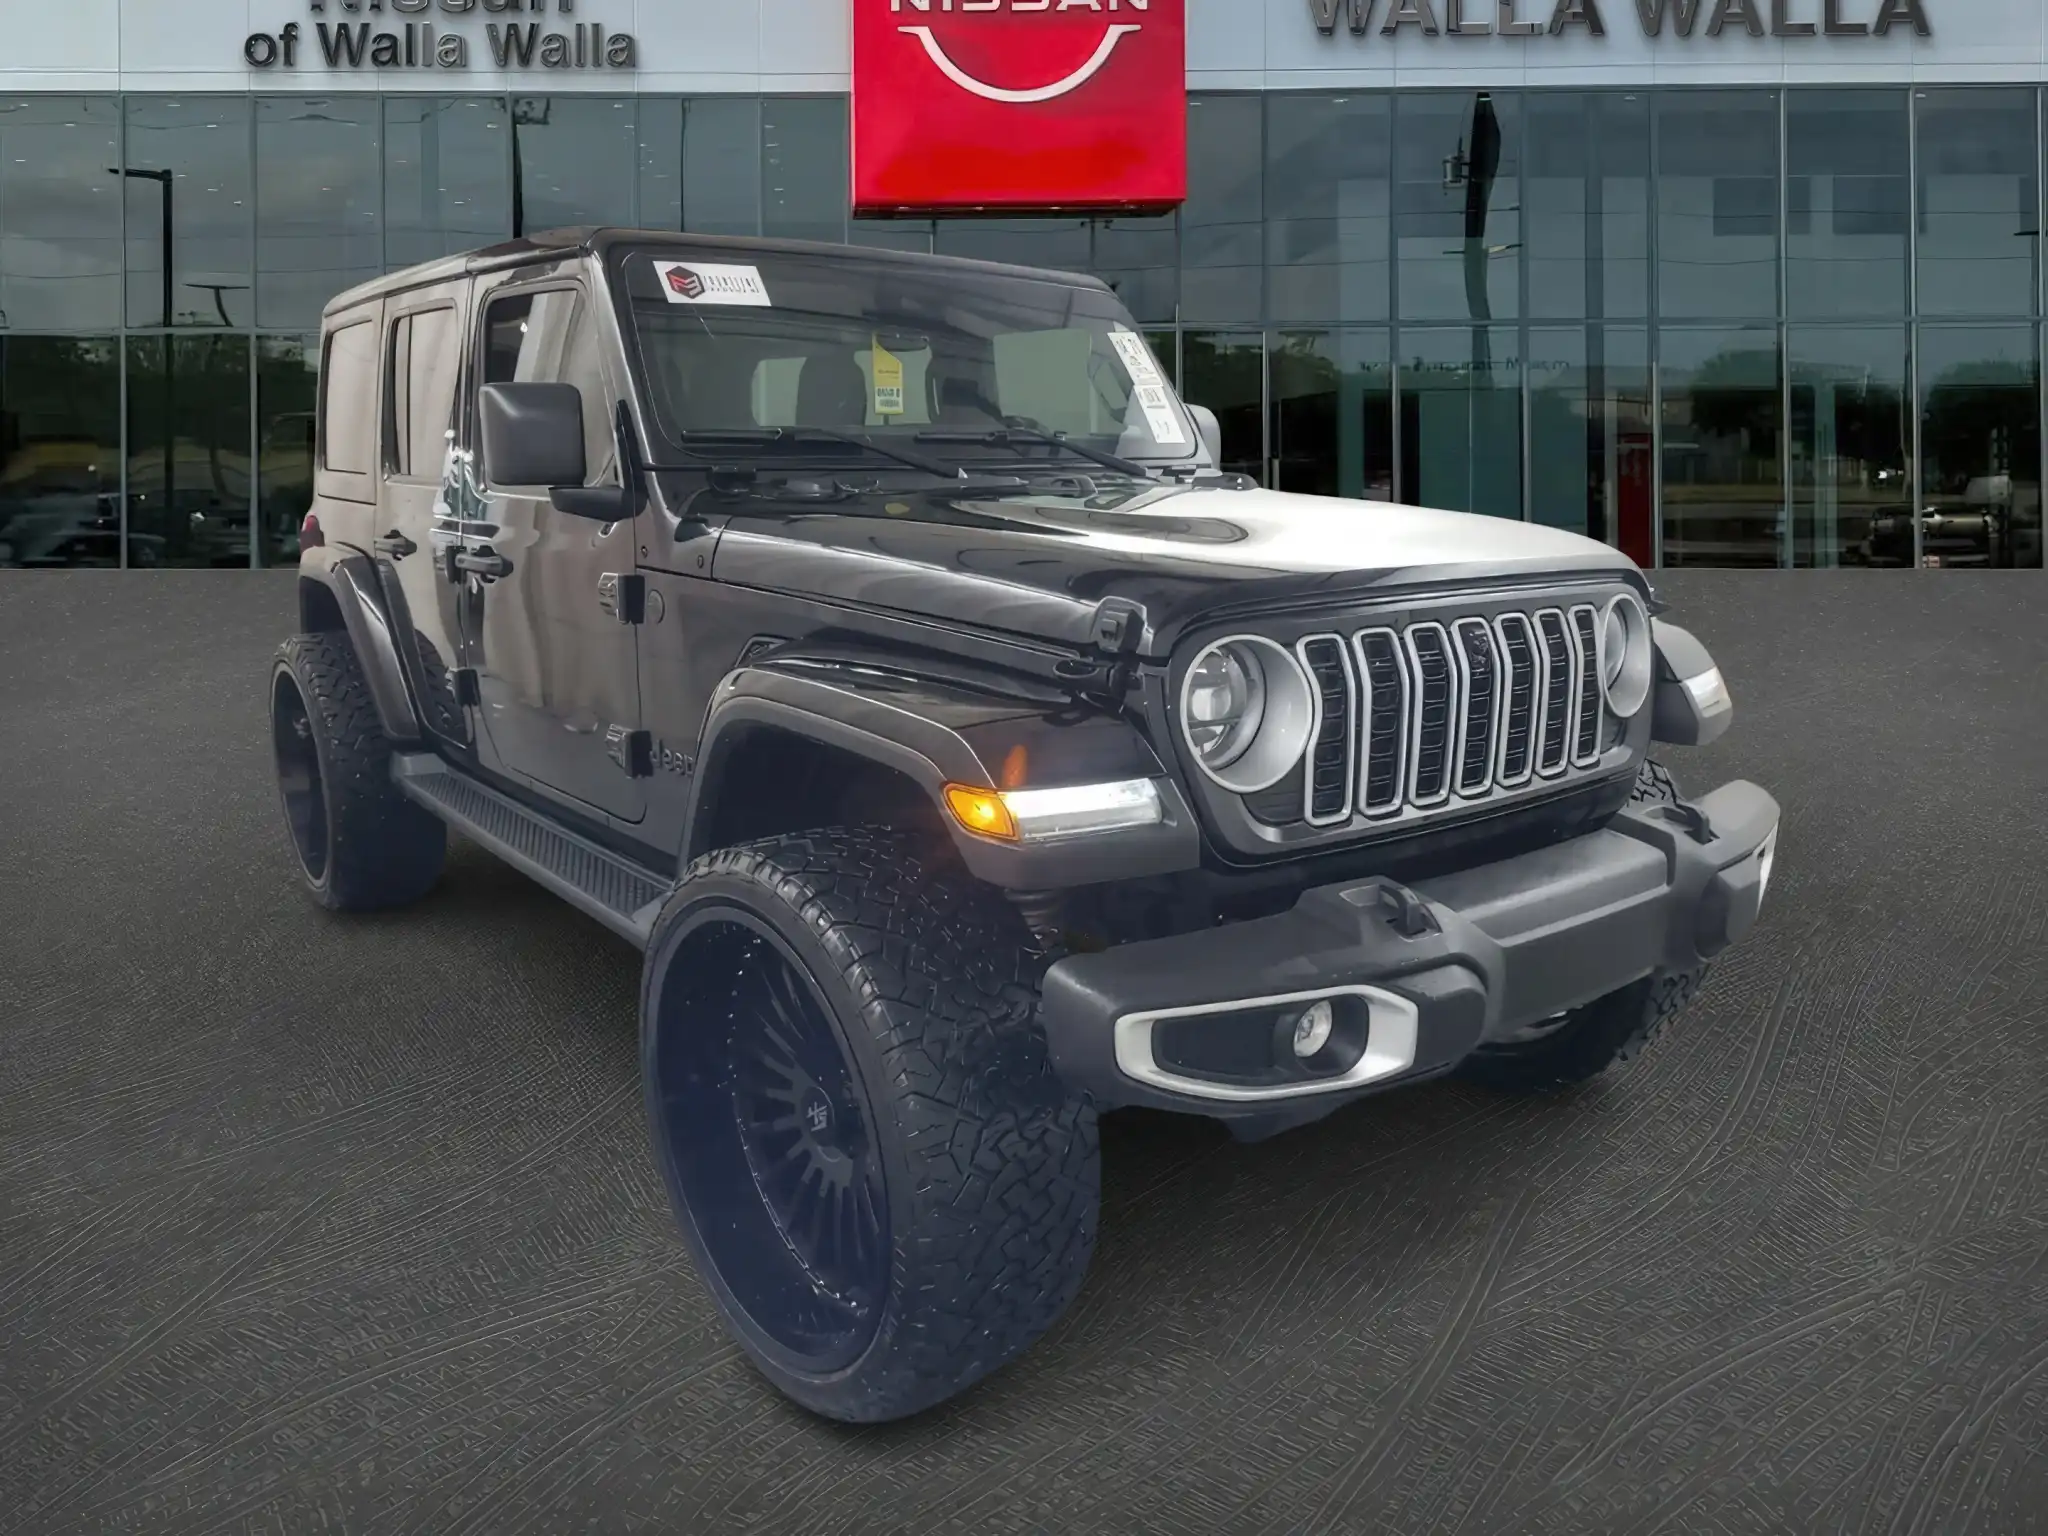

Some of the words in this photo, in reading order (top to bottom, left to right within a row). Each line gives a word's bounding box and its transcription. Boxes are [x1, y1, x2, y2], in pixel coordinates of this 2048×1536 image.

[1308, 0, 1605, 36] WALLA
[1633, 0, 1931, 36] WALLA
[244, 22, 300, 67] of
[316, 22, 467, 67] Walla
[485, 22, 636, 67] Walla
